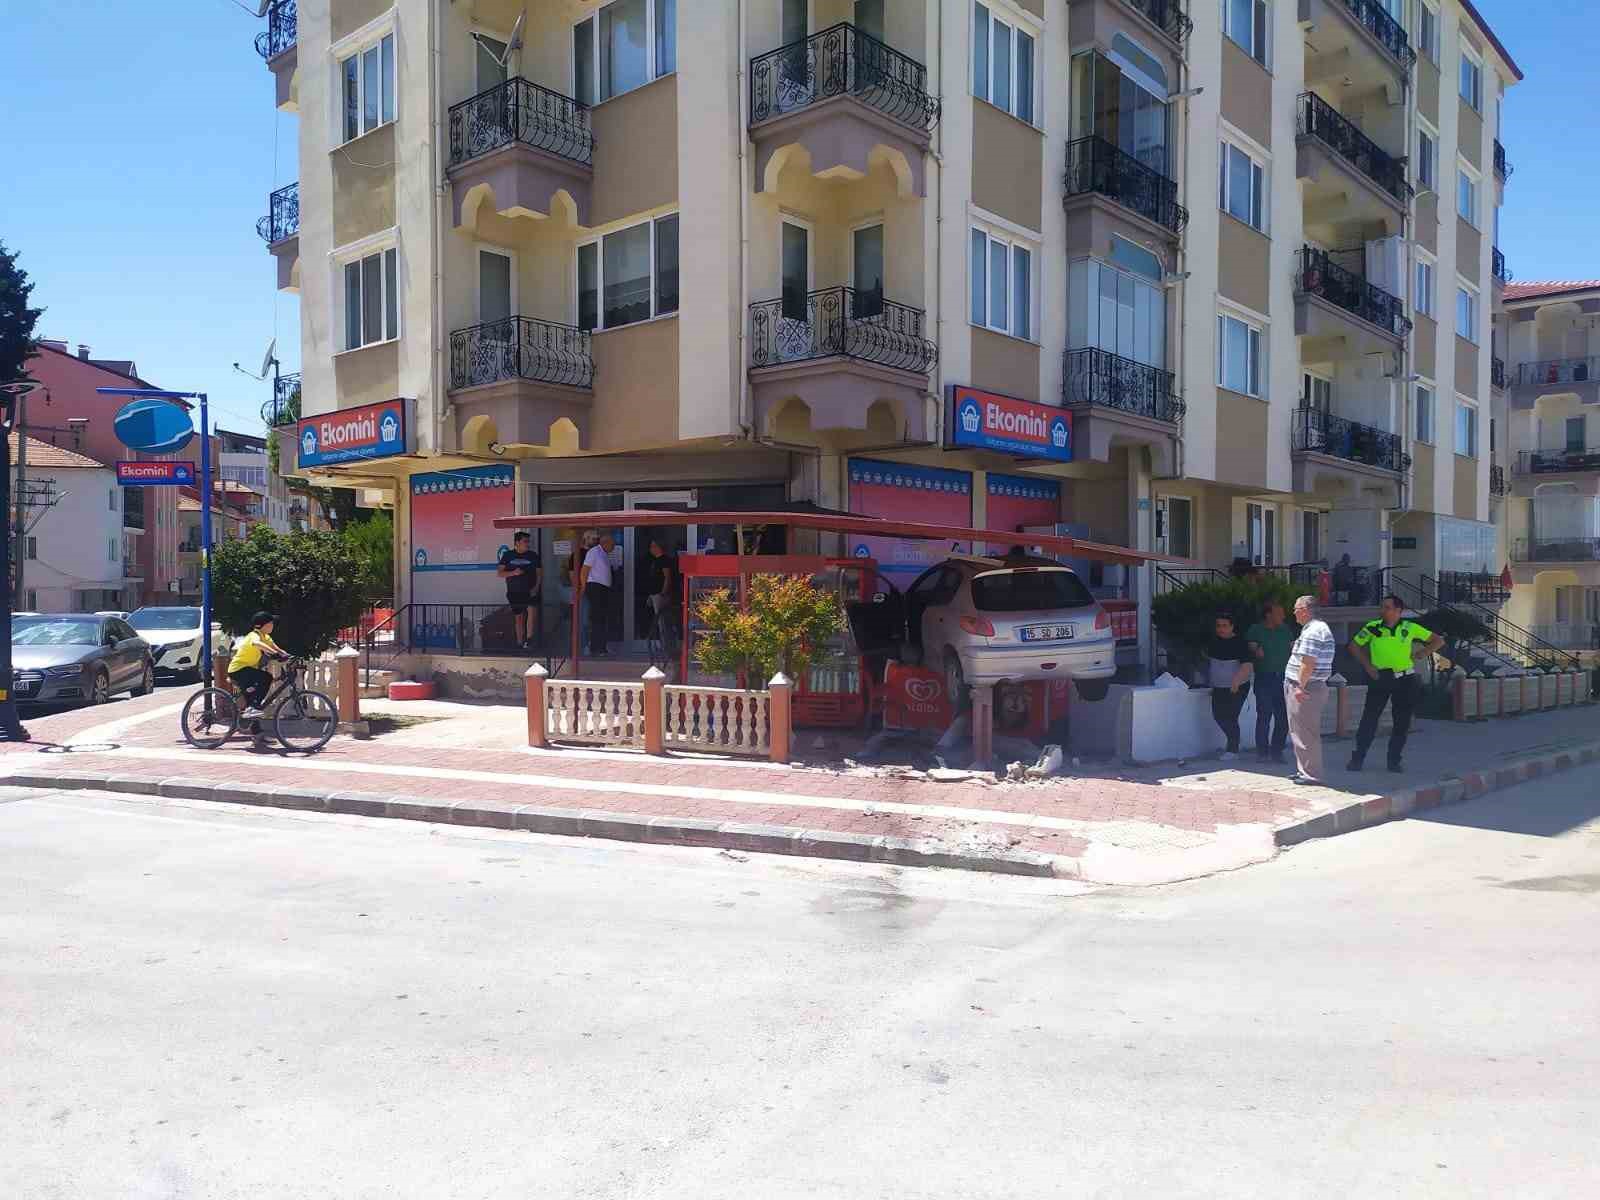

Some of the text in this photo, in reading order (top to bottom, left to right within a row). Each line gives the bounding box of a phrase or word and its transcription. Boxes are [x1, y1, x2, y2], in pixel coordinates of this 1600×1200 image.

[321, 412, 375, 446] Ekomini
[986, 403, 1047, 437] Ekomini
[121, 465, 168, 476] Ekomini
